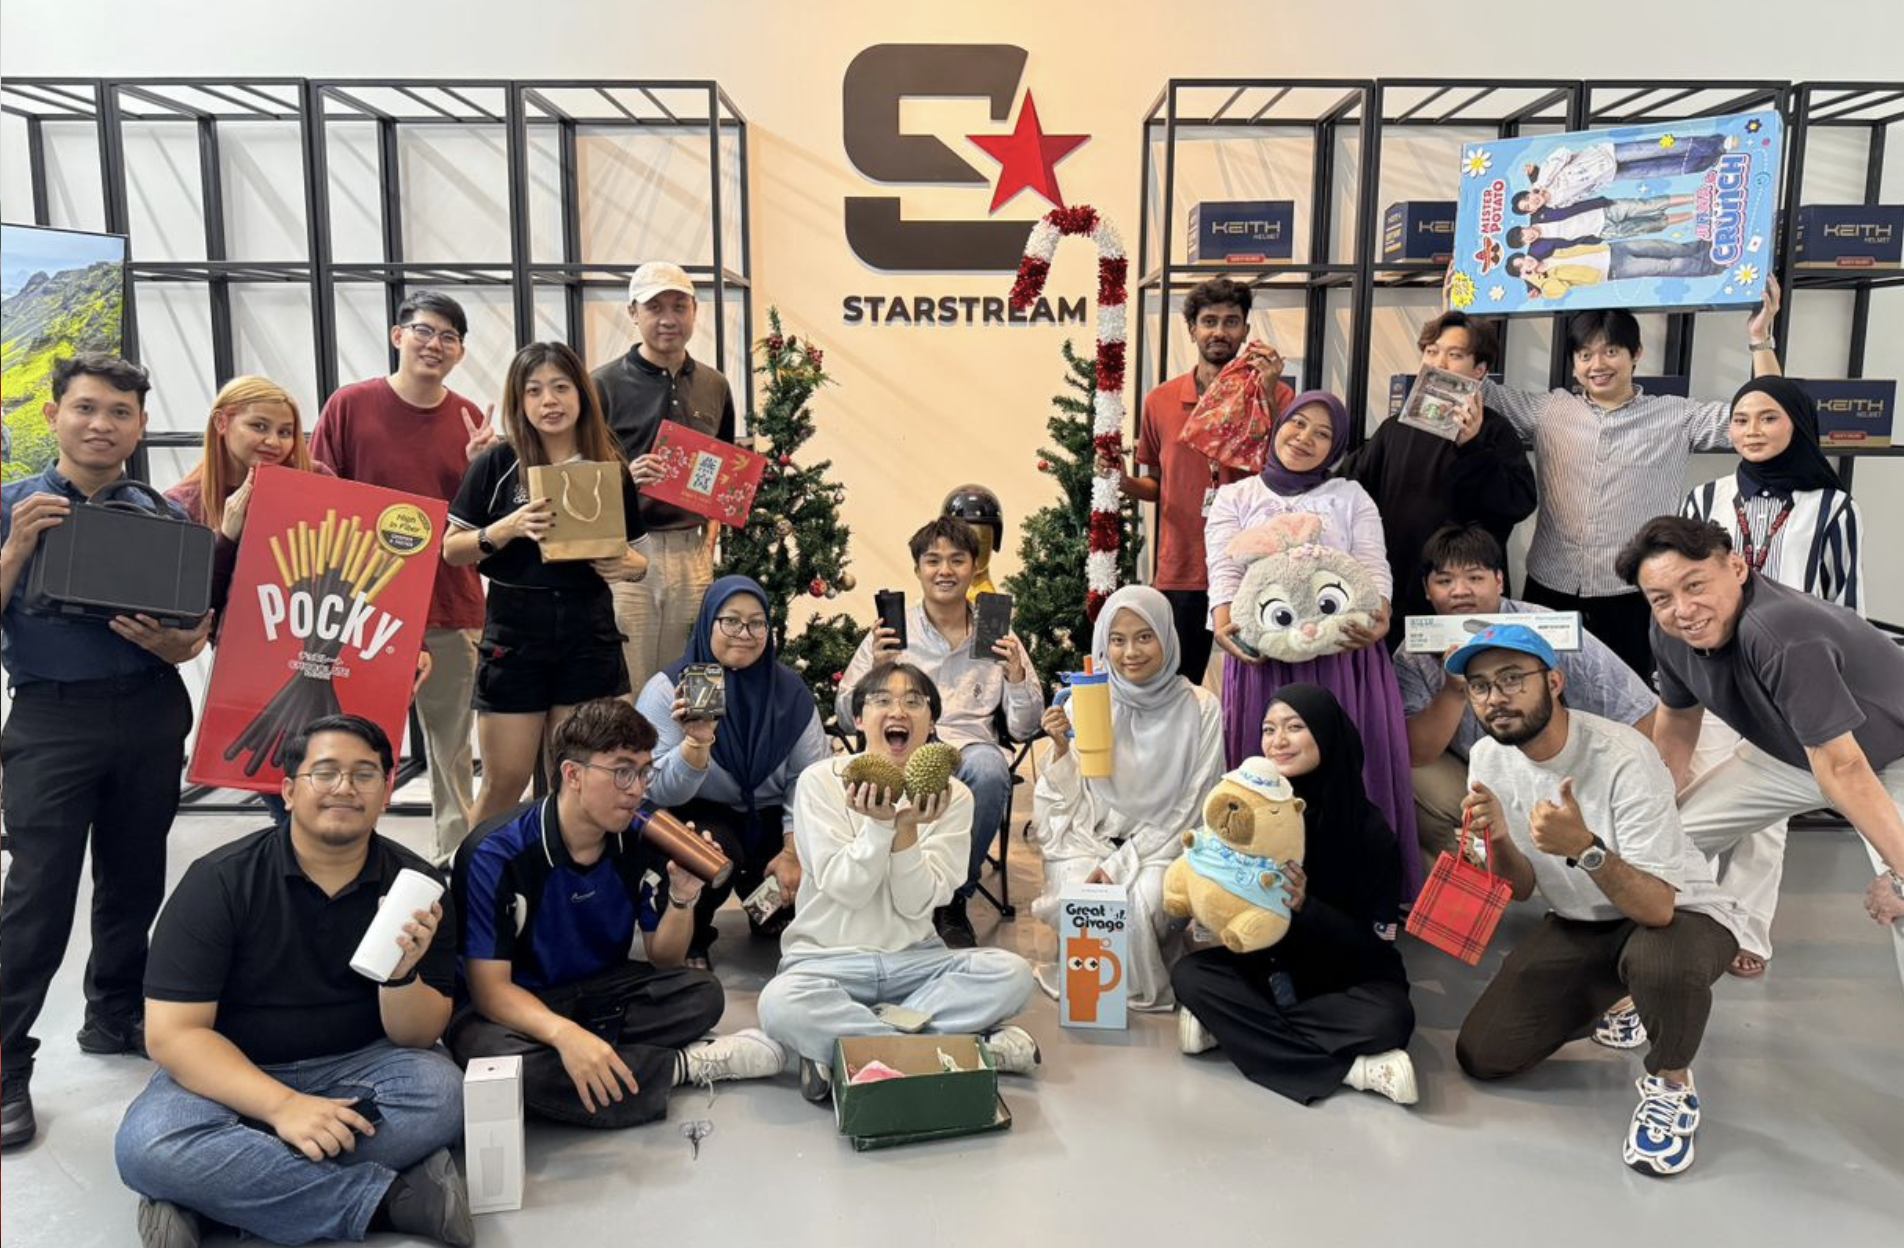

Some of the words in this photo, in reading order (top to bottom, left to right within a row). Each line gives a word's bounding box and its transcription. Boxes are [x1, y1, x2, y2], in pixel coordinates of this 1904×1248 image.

[1481, 190, 1493, 234] MISTER
[1490, 181, 1505, 233] POTATO
[1212, 221, 1280, 234] KEITH
[1418, 221, 1455, 233] KEI
[1823, 224, 1893, 237] KEITH
[843, 296, 1087, 325] STARSTREAM
[1816, 399, 1885, 412] KEITH
[1066, 903, 1106, 917] Great
[1072, 915, 1125, 933] Civago
